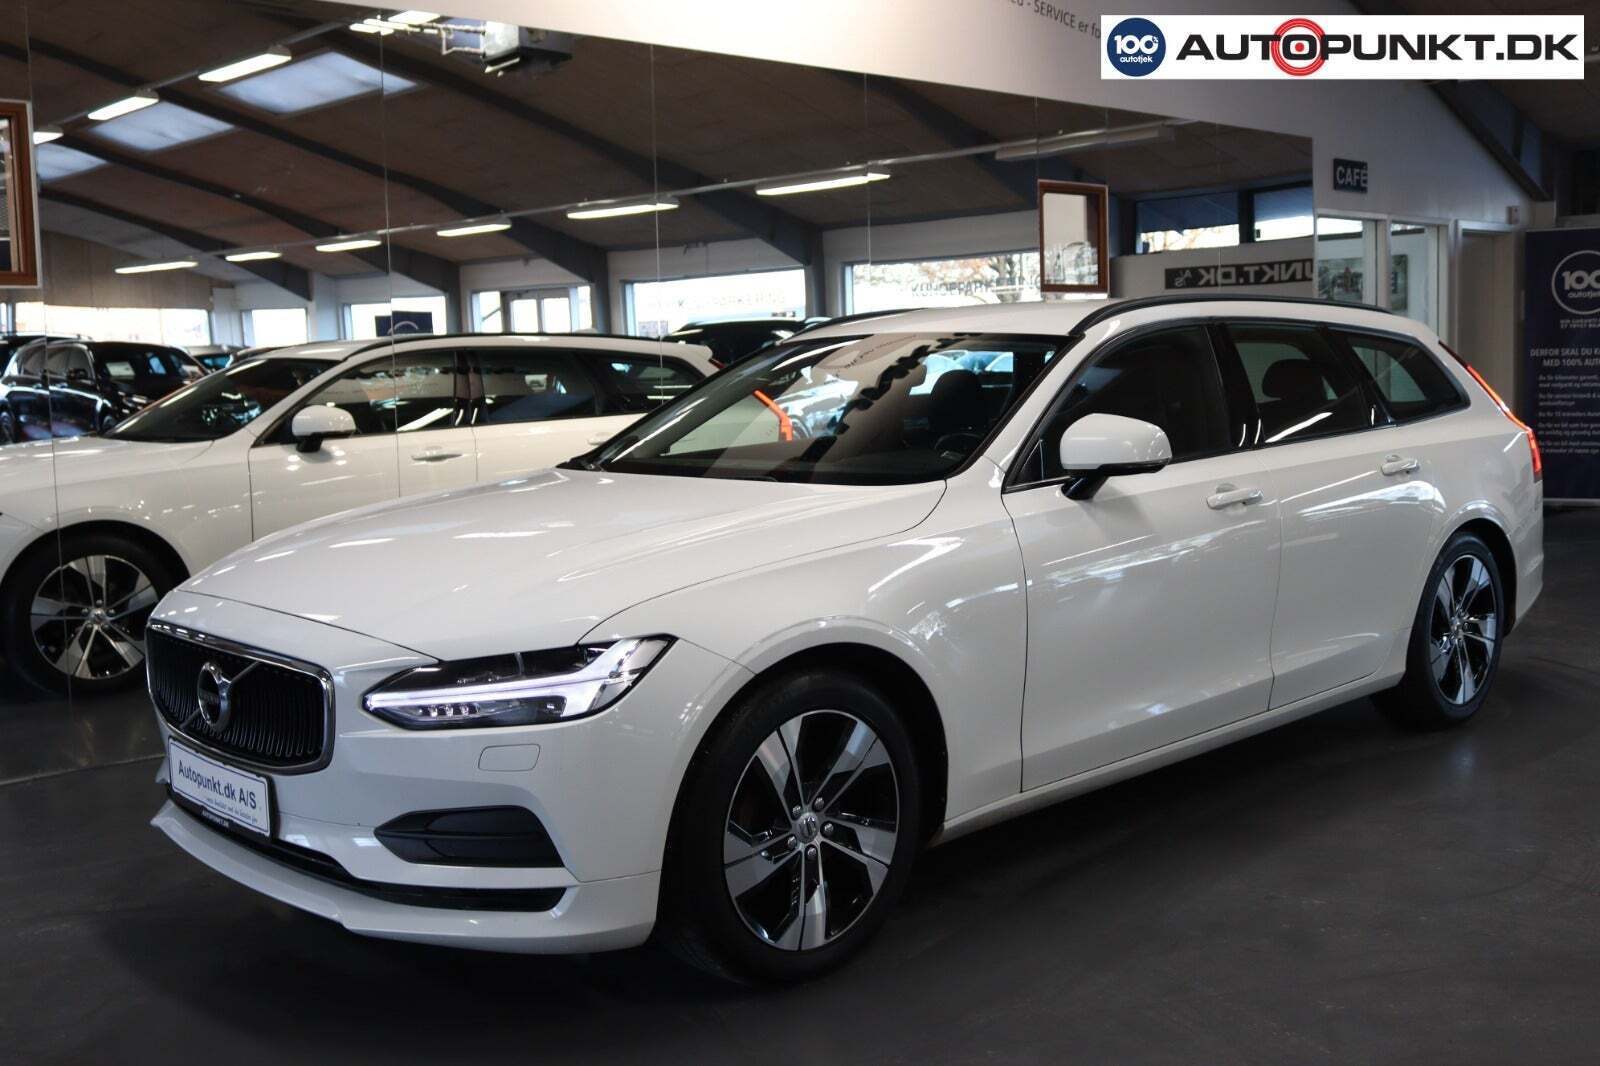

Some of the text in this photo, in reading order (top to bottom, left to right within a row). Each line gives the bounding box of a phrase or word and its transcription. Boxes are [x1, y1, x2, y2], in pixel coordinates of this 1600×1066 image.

[1033, 0, 1076, 29] SERVICE
[1078, 20, 1089, 33] er
[1561, 347, 1579, 356] SKAL
[1581, 347, 1592, 356] DU
[1543, 358, 1560, 367] MED
[1562, 358, 1583, 366] 100%
[178, 759, 237, 802] Autopunkt.dk
[239, 787, 257, 810] A/S
